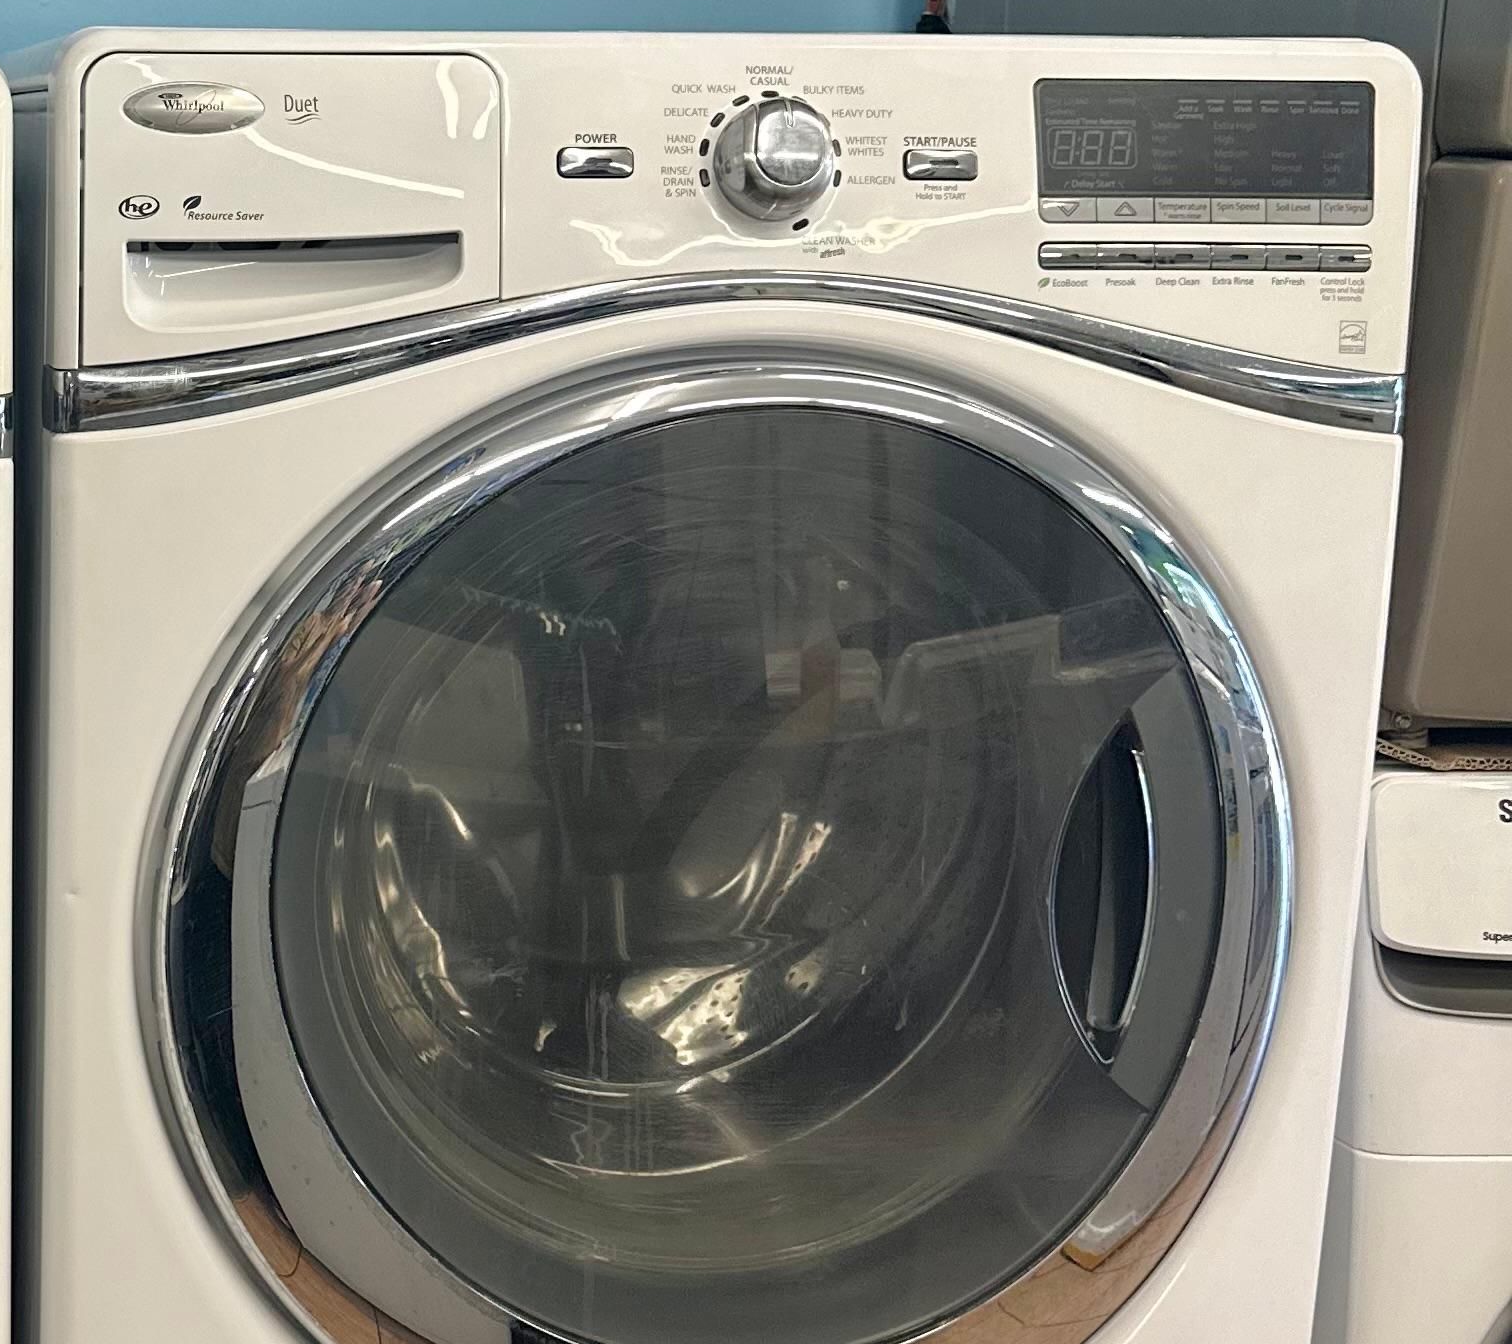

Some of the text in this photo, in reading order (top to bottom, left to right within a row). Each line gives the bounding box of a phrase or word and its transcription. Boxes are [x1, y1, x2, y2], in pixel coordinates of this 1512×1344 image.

[745, 65, 794, 77] NORMAL/
[749, 76, 790, 87] CASUAL
[671, 84, 736, 95] QUICK WASH
[803, 85, 865, 96] BULKY ITEMS
[161, 99, 225, 114] Whirlpool
[284, 94, 319, 113] Duet
[664, 107, 709, 118] DELICATE
[831, 108, 893, 119] HEAVY DUTY
[575, 133, 618, 145] POWER
[666, 133, 696, 144] HAND
[845, 136, 888, 147] WHITEST
[903, 136, 977, 149] START/PAUSE
[664, 145, 694, 156] WASH
[847, 147, 884, 157] WHITES
[660, 166, 693, 177] RINSE/
[663, 177, 694, 187] DRAIN
[847, 175, 896, 186] ALLERGEN
[665, 188, 696, 198] & SPIN
[923, 184, 958, 193] Press and
[1157, 202, 1207, 212] Temperature
[1216, 202, 1260, 212] Spin Speed
[1323, 203, 1368, 213] Cycle Signal
[187, 210, 265, 222] Resource Saver
[834, 236, 876, 246] WASHER
[1052, 278, 1088, 287] EcoBoost
[1105, 277, 1136, 286] Presoak
[1155, 277, 1200, 287] Deep Clean
[1212, 277, 1254, 286] Extra Rinse
[1271, 277, 1305, 286] FanFresh
[1320, 277, 1365, 286] Control Lock
